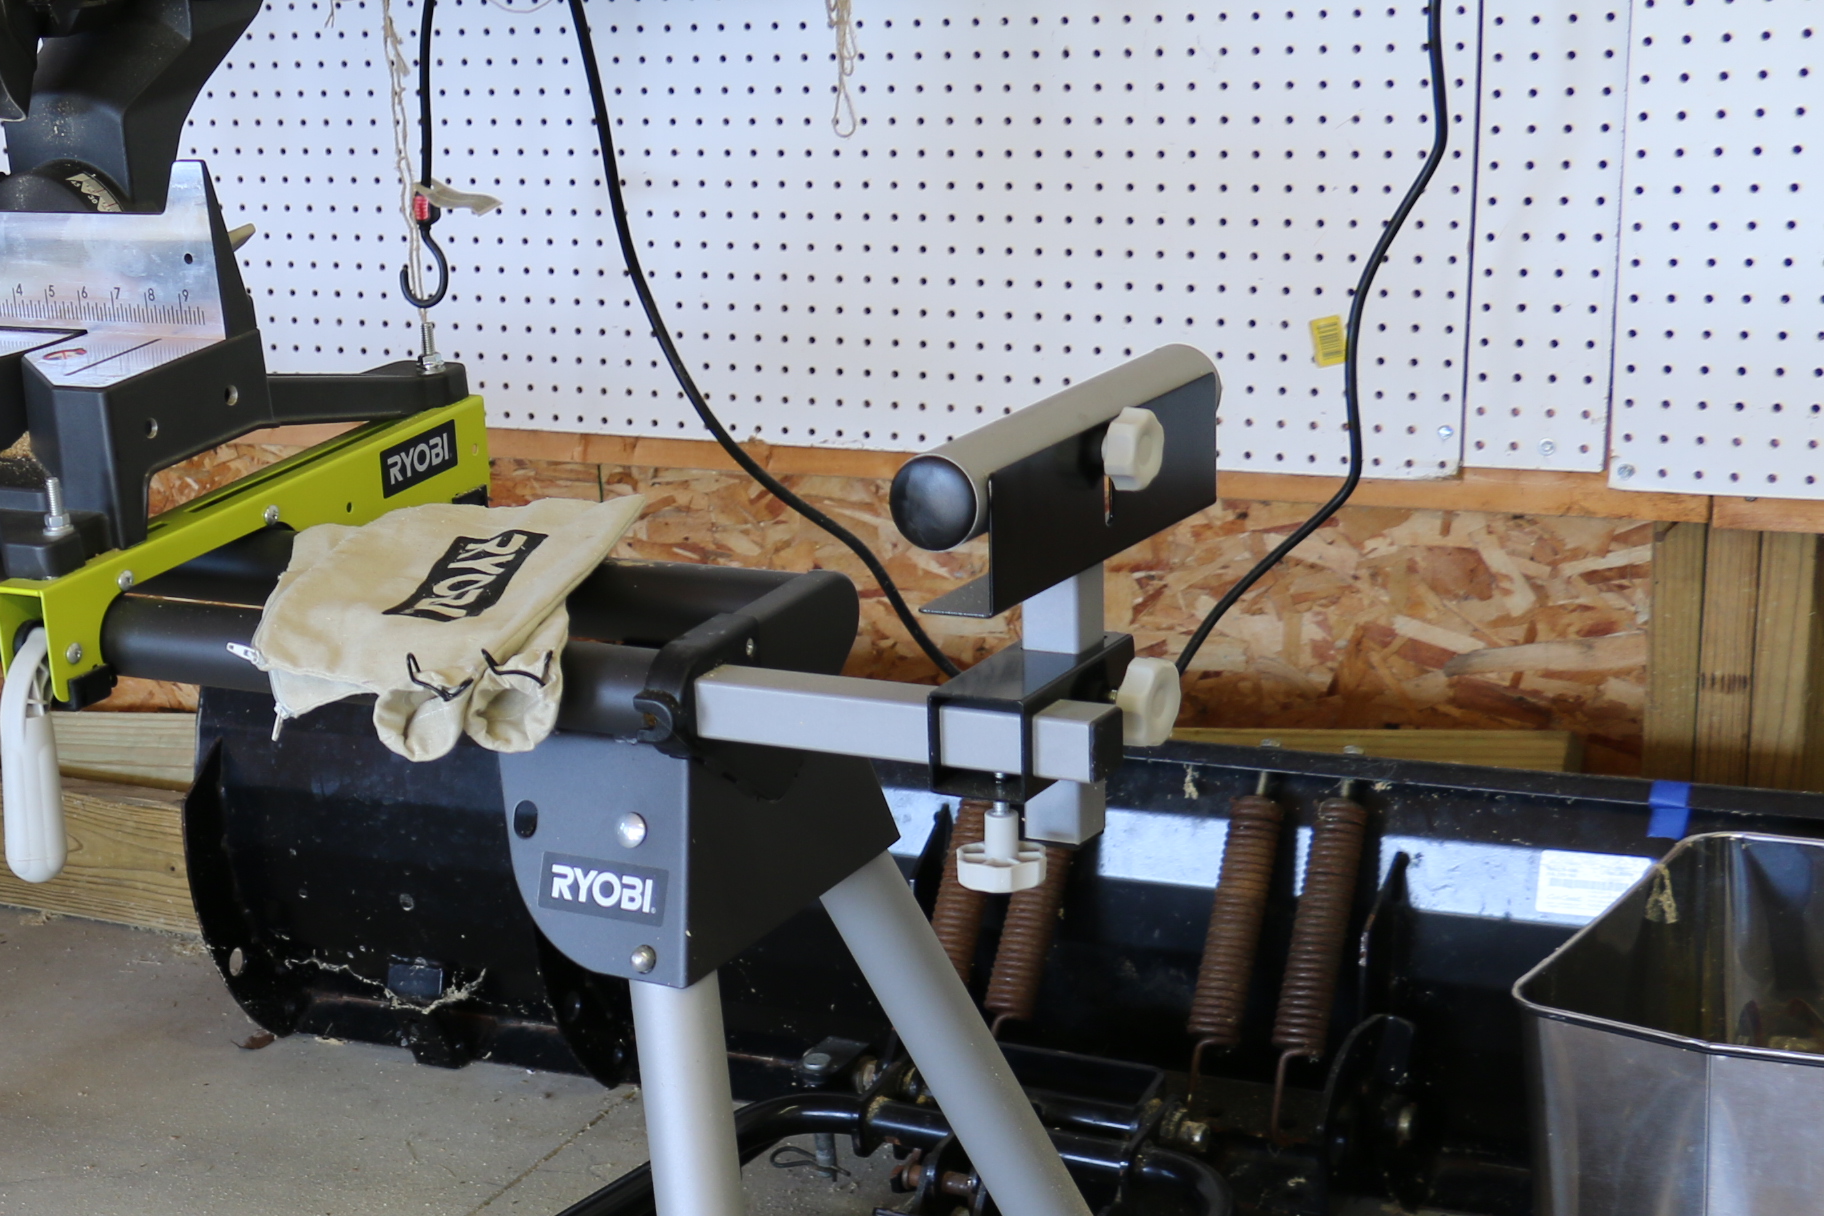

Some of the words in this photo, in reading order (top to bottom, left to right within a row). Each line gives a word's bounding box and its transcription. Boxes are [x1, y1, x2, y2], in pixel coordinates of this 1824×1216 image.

[16, 283, 23, 296] 4
[48, 285, 55, 298] 5
[81, 286, 88, 299] 6
[113, 287, 121, 300] 7
[147, 288, 155, 301] 8
[181, 289, 189, 302] 9
[387, 432, 449, 485] RYOBI
[551, 863, 653, 913] RYOBI
